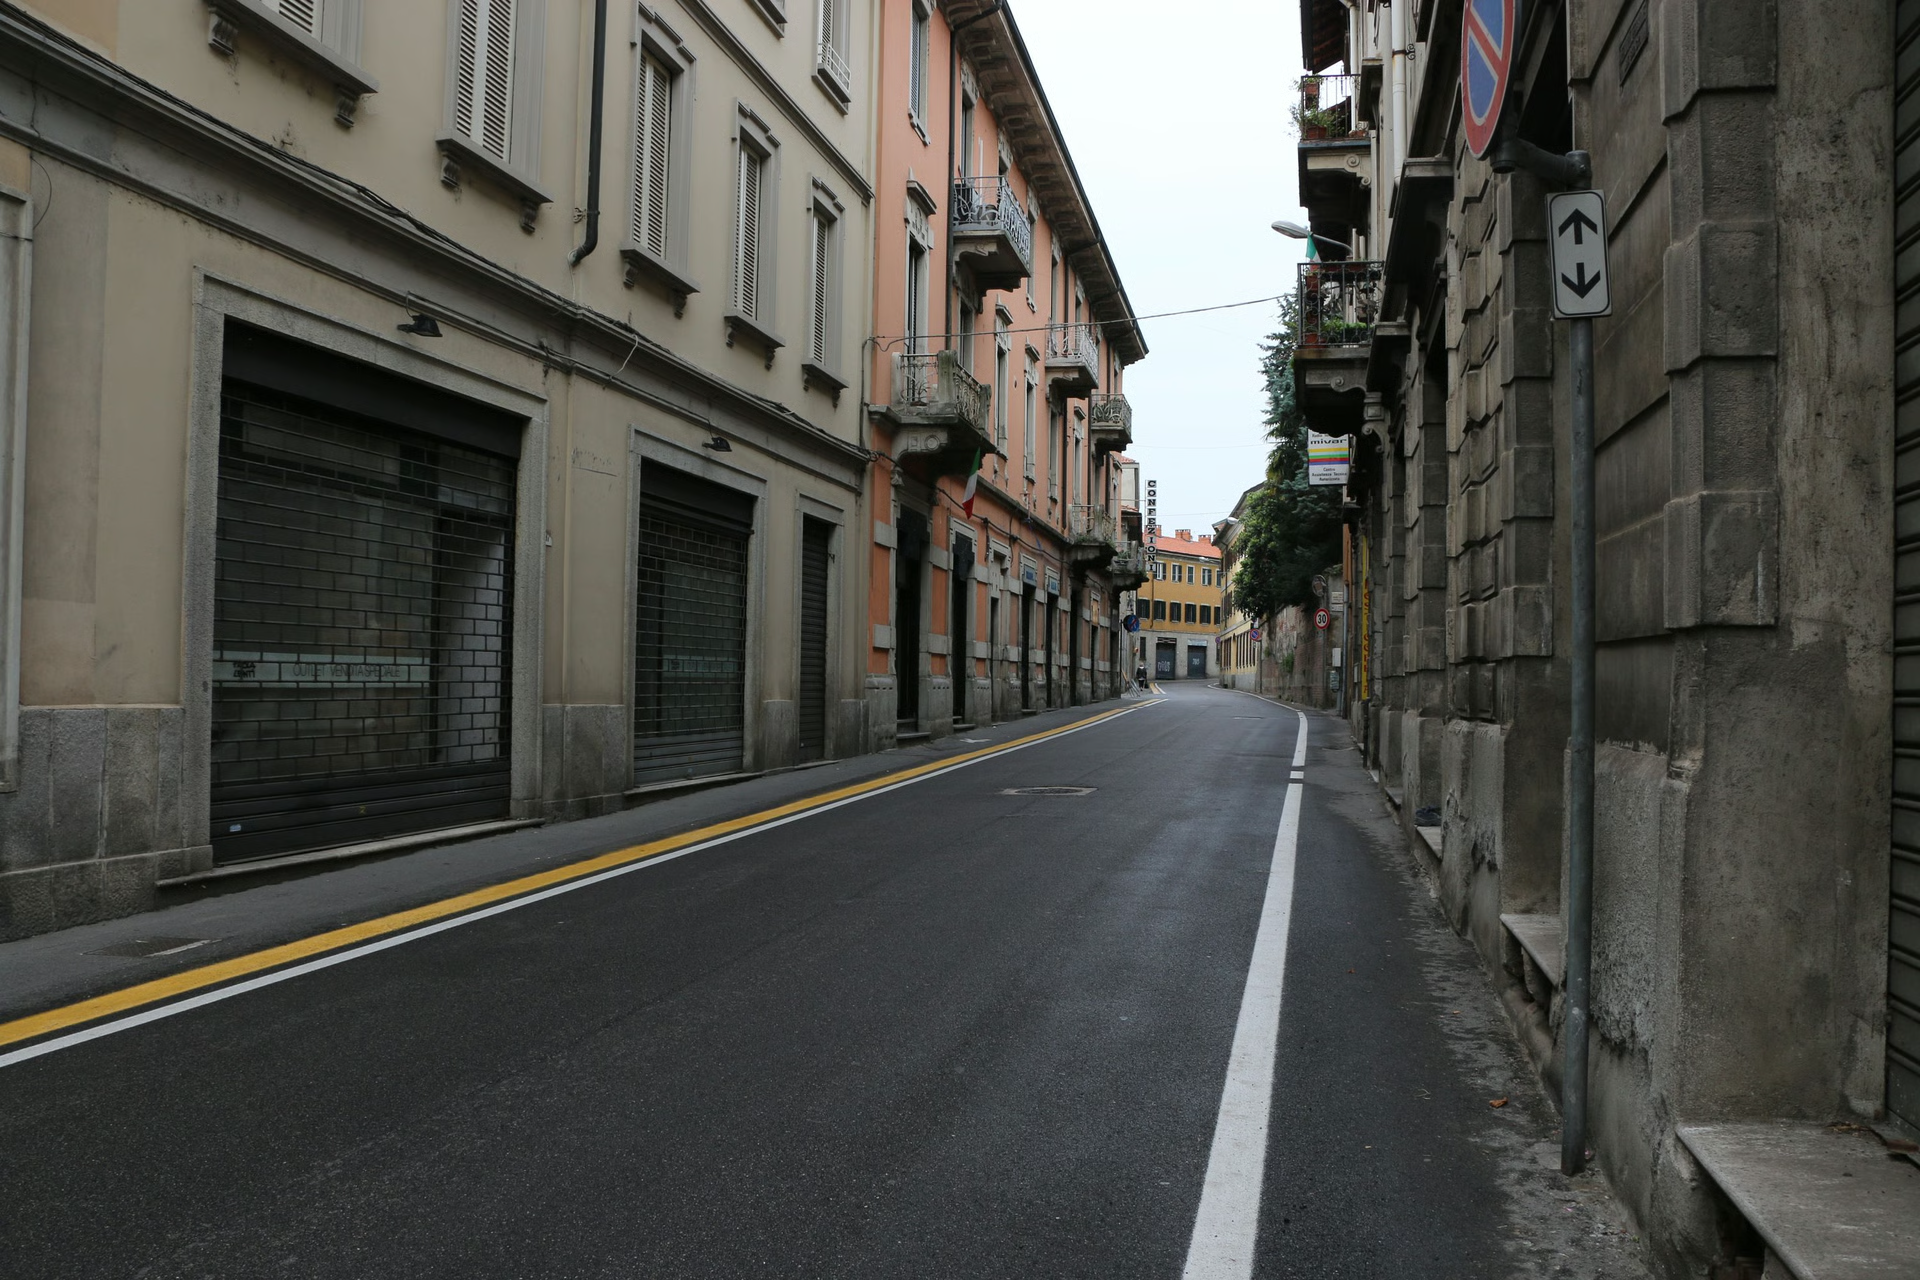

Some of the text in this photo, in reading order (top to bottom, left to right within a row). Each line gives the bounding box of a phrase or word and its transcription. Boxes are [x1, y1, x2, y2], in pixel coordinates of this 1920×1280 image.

[1147, 479, 1157, 571] CONFEZIONI
[1317, 614, 1327, 624] 30
[293, 663, 325, 677] OUTLET
